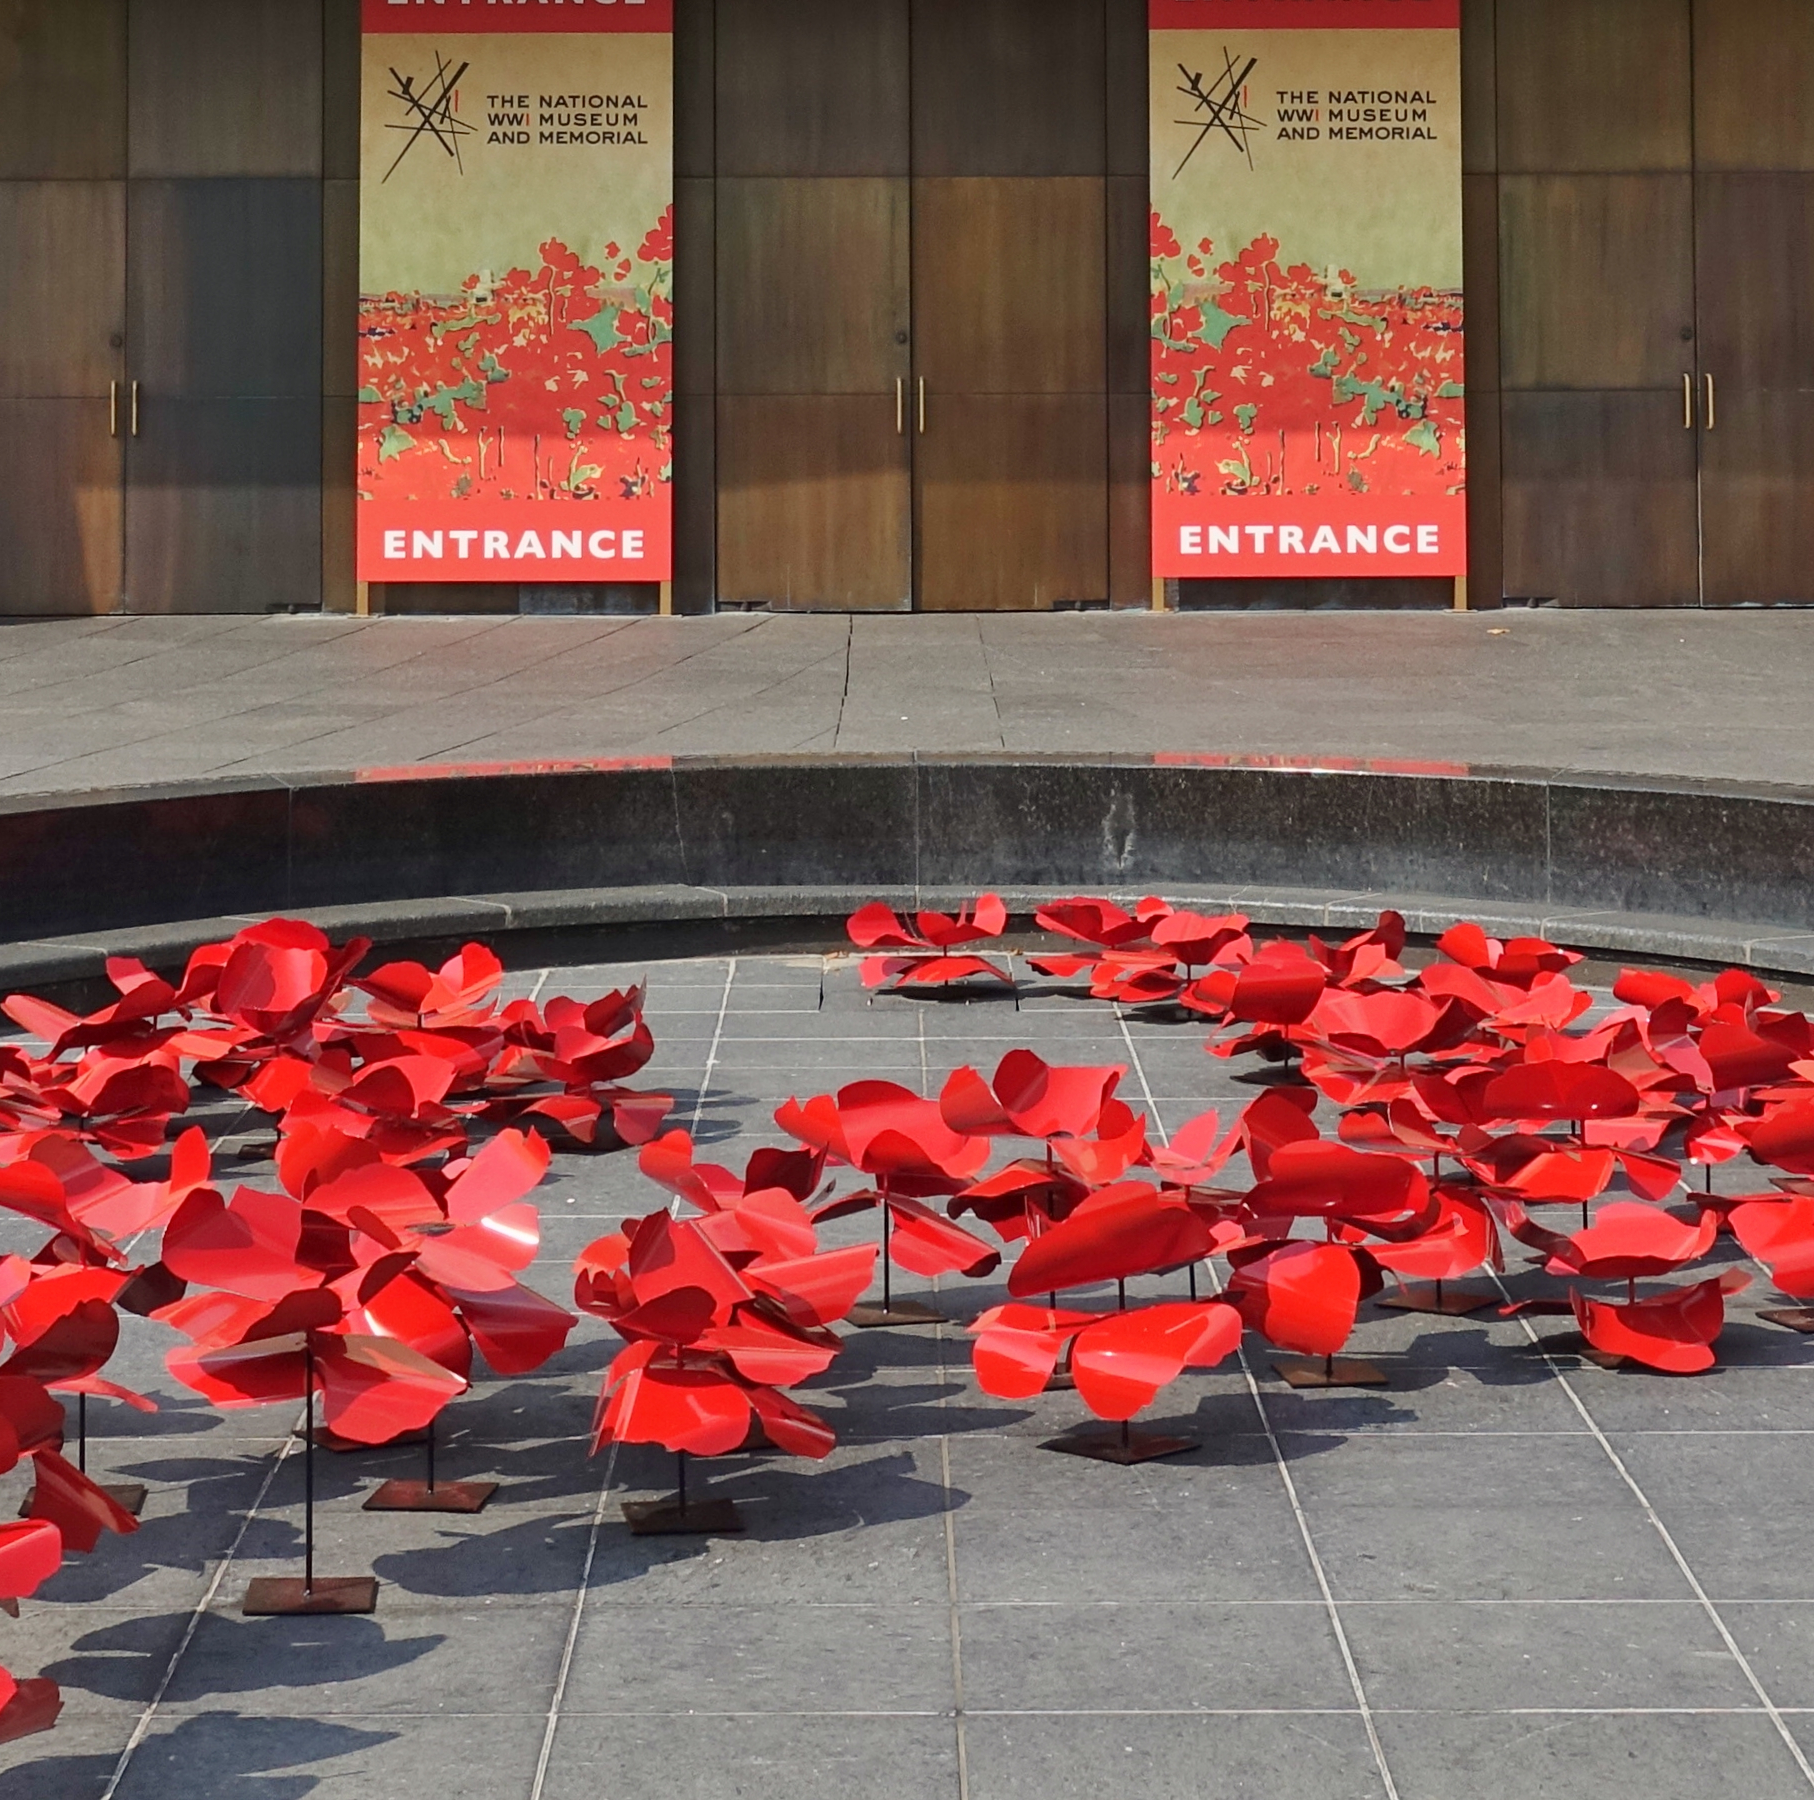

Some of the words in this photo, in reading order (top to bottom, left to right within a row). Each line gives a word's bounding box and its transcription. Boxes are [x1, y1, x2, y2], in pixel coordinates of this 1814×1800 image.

[487, 94, 530, 109] THE
[539, 94, 648, 109] NATIONAL
[1276, 90, 1319, 105] THE
[1328, 90, 1437, 105] NATIONAL
[487, 112, 530, 127] WWI
[539, 112, 639, 127] MUSEUM
[1276, 108, 1320, 123] WWI
[1328, 108, 1428, 123] MUSEUM
[486, 130, 531, 145] AND
[538, 130, 649, 145] MEMORIAL
[1276, 126, 1320, 141] AND
[1328, 126, 1438, 141] MEMORIAL
[383, 529, 645, 559] ENTRANCE
[1179, 524, 1440, 555] ENTRANCE
